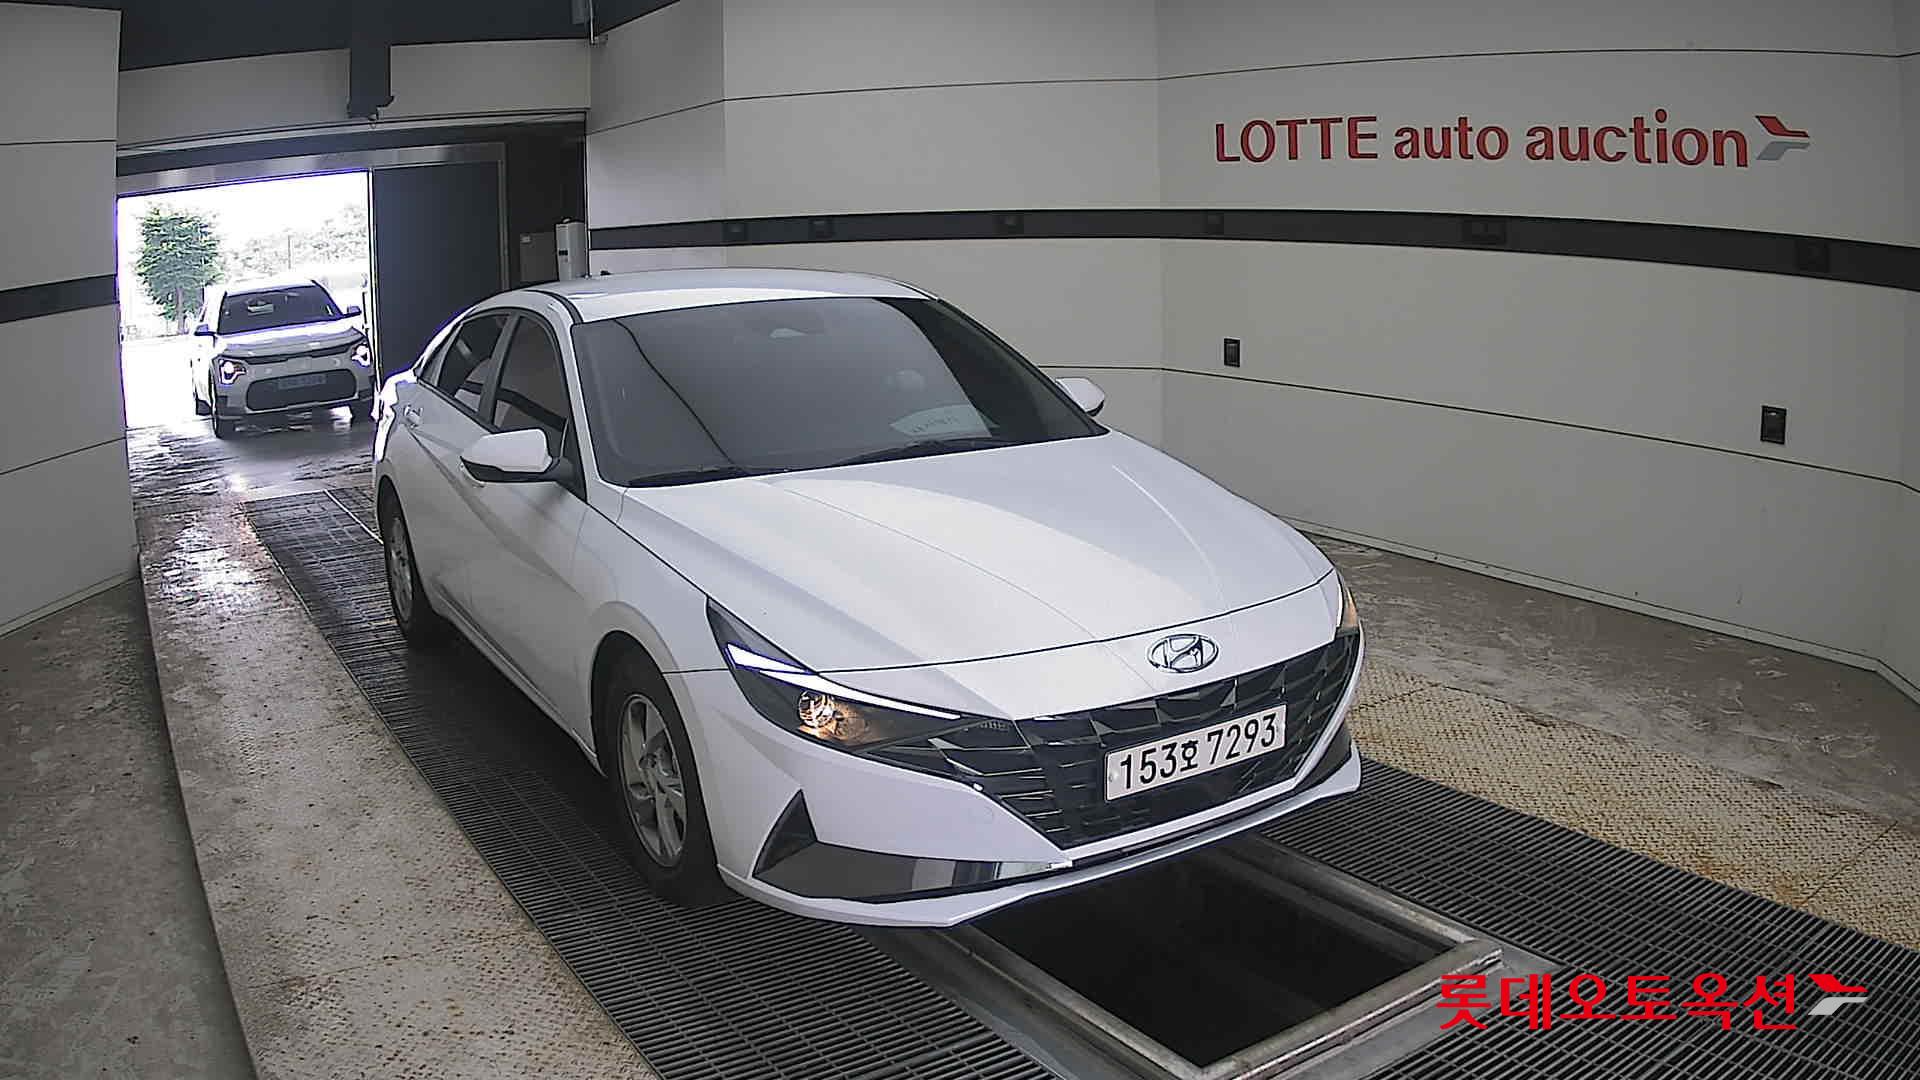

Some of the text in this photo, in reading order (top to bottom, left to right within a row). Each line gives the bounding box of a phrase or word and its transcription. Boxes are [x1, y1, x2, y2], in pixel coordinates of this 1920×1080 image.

[1215, 108, 1749, 168] LOTTE auto auction
[1120, 714, 1276, 789] 153호 7293
